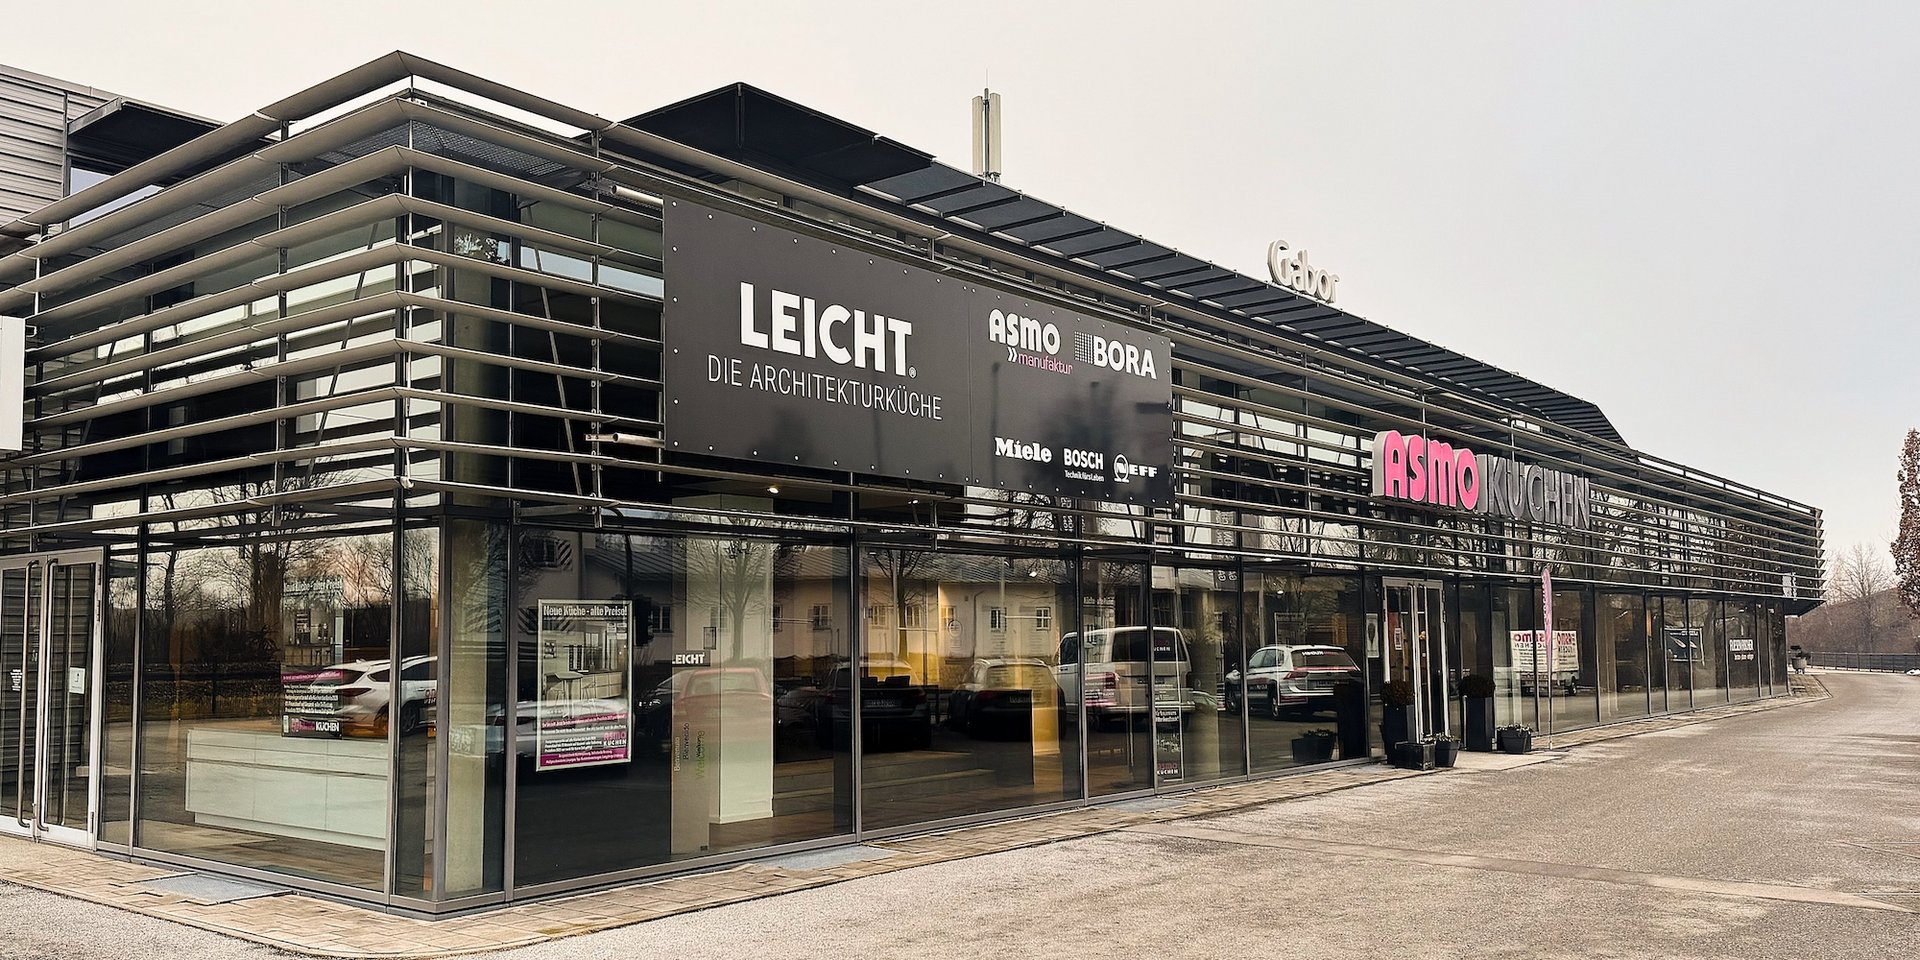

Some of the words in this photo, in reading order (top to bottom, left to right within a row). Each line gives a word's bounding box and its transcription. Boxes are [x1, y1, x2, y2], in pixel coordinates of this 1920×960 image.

[1267, 240, 1340, 303] Gabor
[740, 281, 913, 377] LEICHT
[989, 308, 1061, 356] ASMO
[1092, 335, 1158, 380] BORA
[1018, 352, 1073, 375] manufaktur
[707, 354, 743, 387] DIE
[750, 362, 943, 421] ARCHITEKTURKÜCHE
[994, 437, 1053, 463] Miele
[1063, 447, 1104, 470] BOSCH
[543, 605, 562, 616] Neue
[563, 605, 586, 616] Küche
[590, 605, 604, 616] alte
